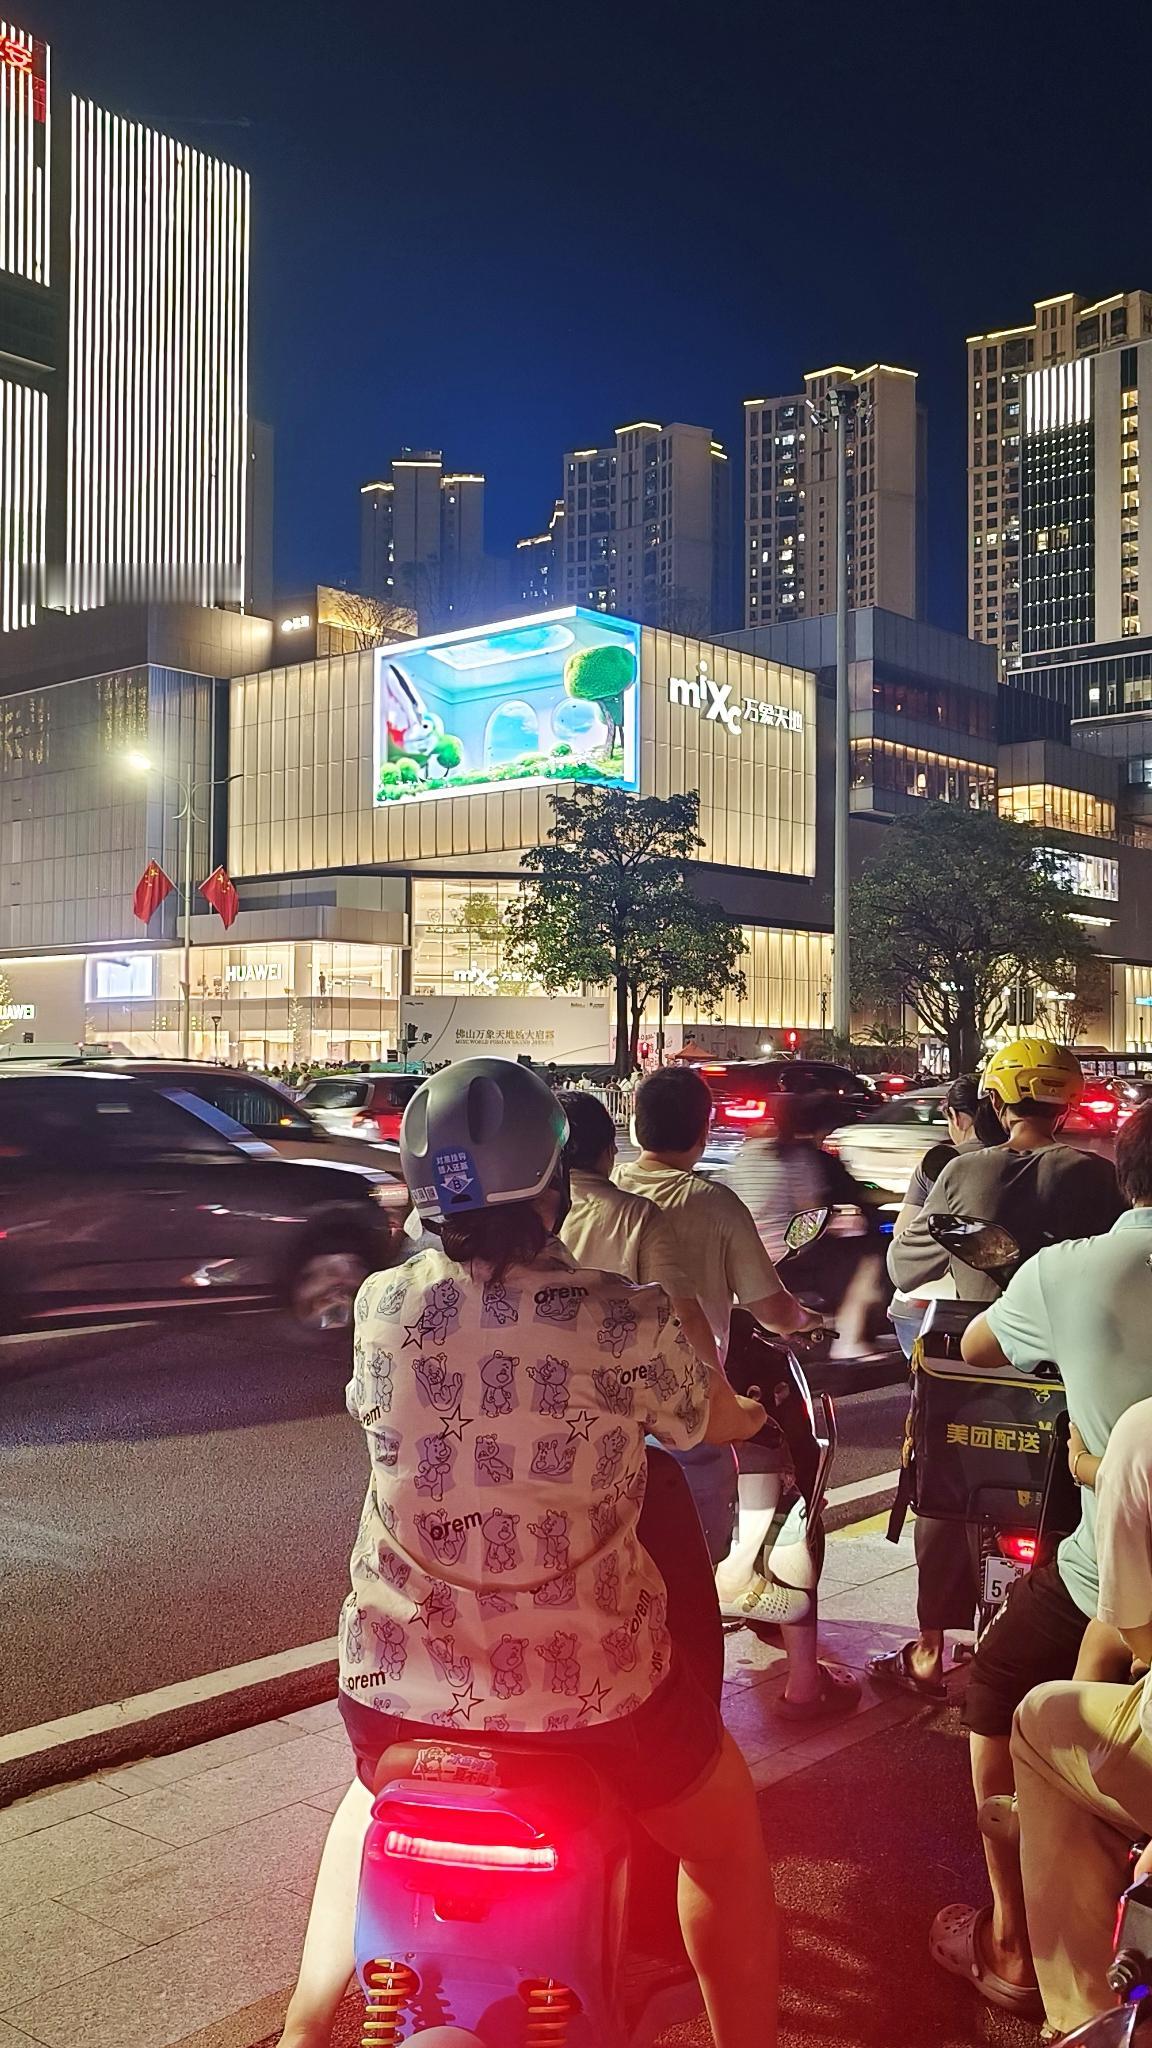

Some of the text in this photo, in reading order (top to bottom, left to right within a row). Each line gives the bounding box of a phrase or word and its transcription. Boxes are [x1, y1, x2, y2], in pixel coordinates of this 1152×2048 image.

[741, 697, 803, 733] 万象天地
[225, 964, 282, 982] HUAWEI
[534, 1286, 589, 1304] orem
[361, 1405, 381, 1426] rem
[946, 1423, 1041, 1454] 美团配送
[430, 1511, 483, 1541] orem
[631, 1588, 652, 1634] orem
[347, 1670, 387, 1691] orem
